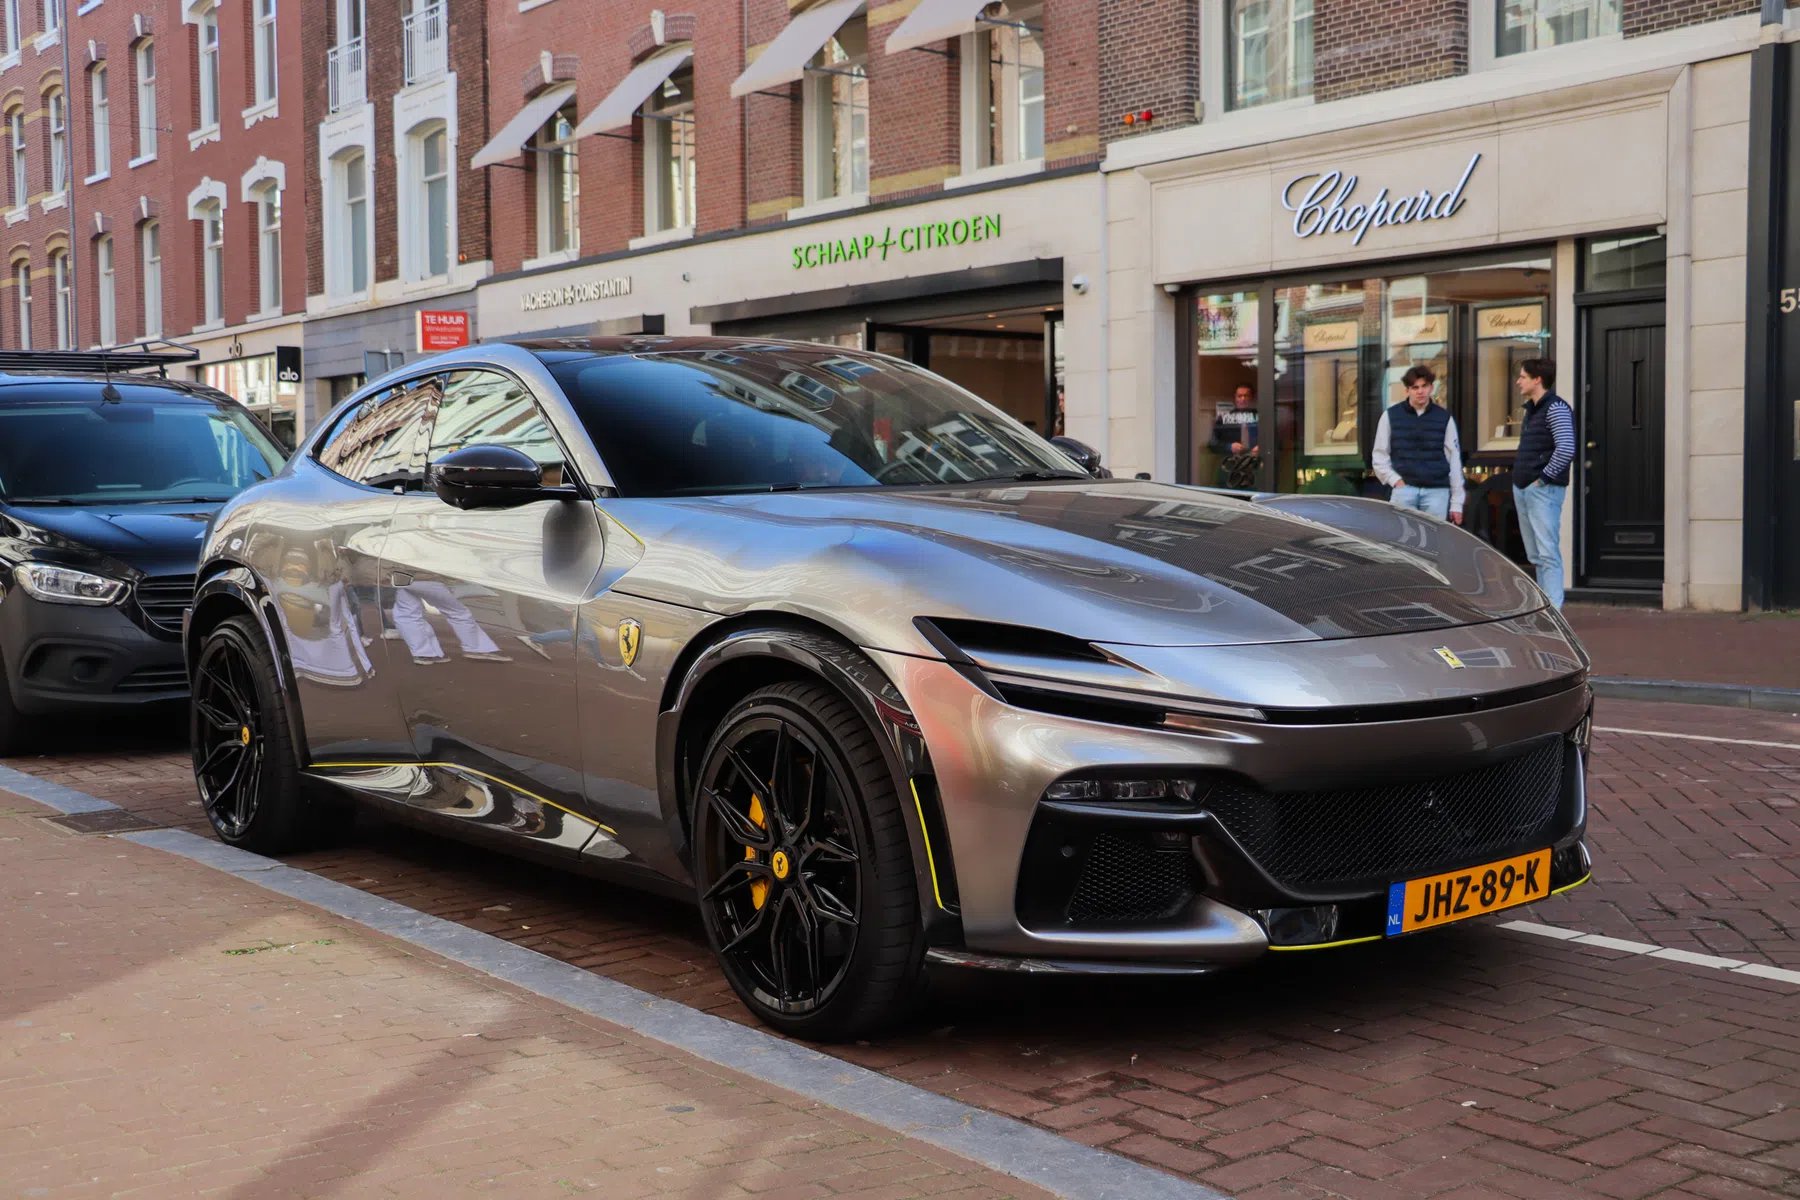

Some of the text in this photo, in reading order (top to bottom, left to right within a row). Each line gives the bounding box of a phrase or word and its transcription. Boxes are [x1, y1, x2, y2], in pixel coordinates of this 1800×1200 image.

[1282, 153, 1482, 246] Chopard
[792, 234, 874, 269] SCHAAP
[900, 213, 1001, 253] CITROEN
[521, 276, 632, 312] VACHERON CONSTANTIN
[1780, 288, 1800, 314] 5
[424, 314, 465, 325] TE HUUR
[1487, 312, 1531, 328] Chopard
[279, 366, 299, 381] alo
[1414, 857, 1541, 923] JHZ-89-K
[1388, 914, 1401, 925] NL
